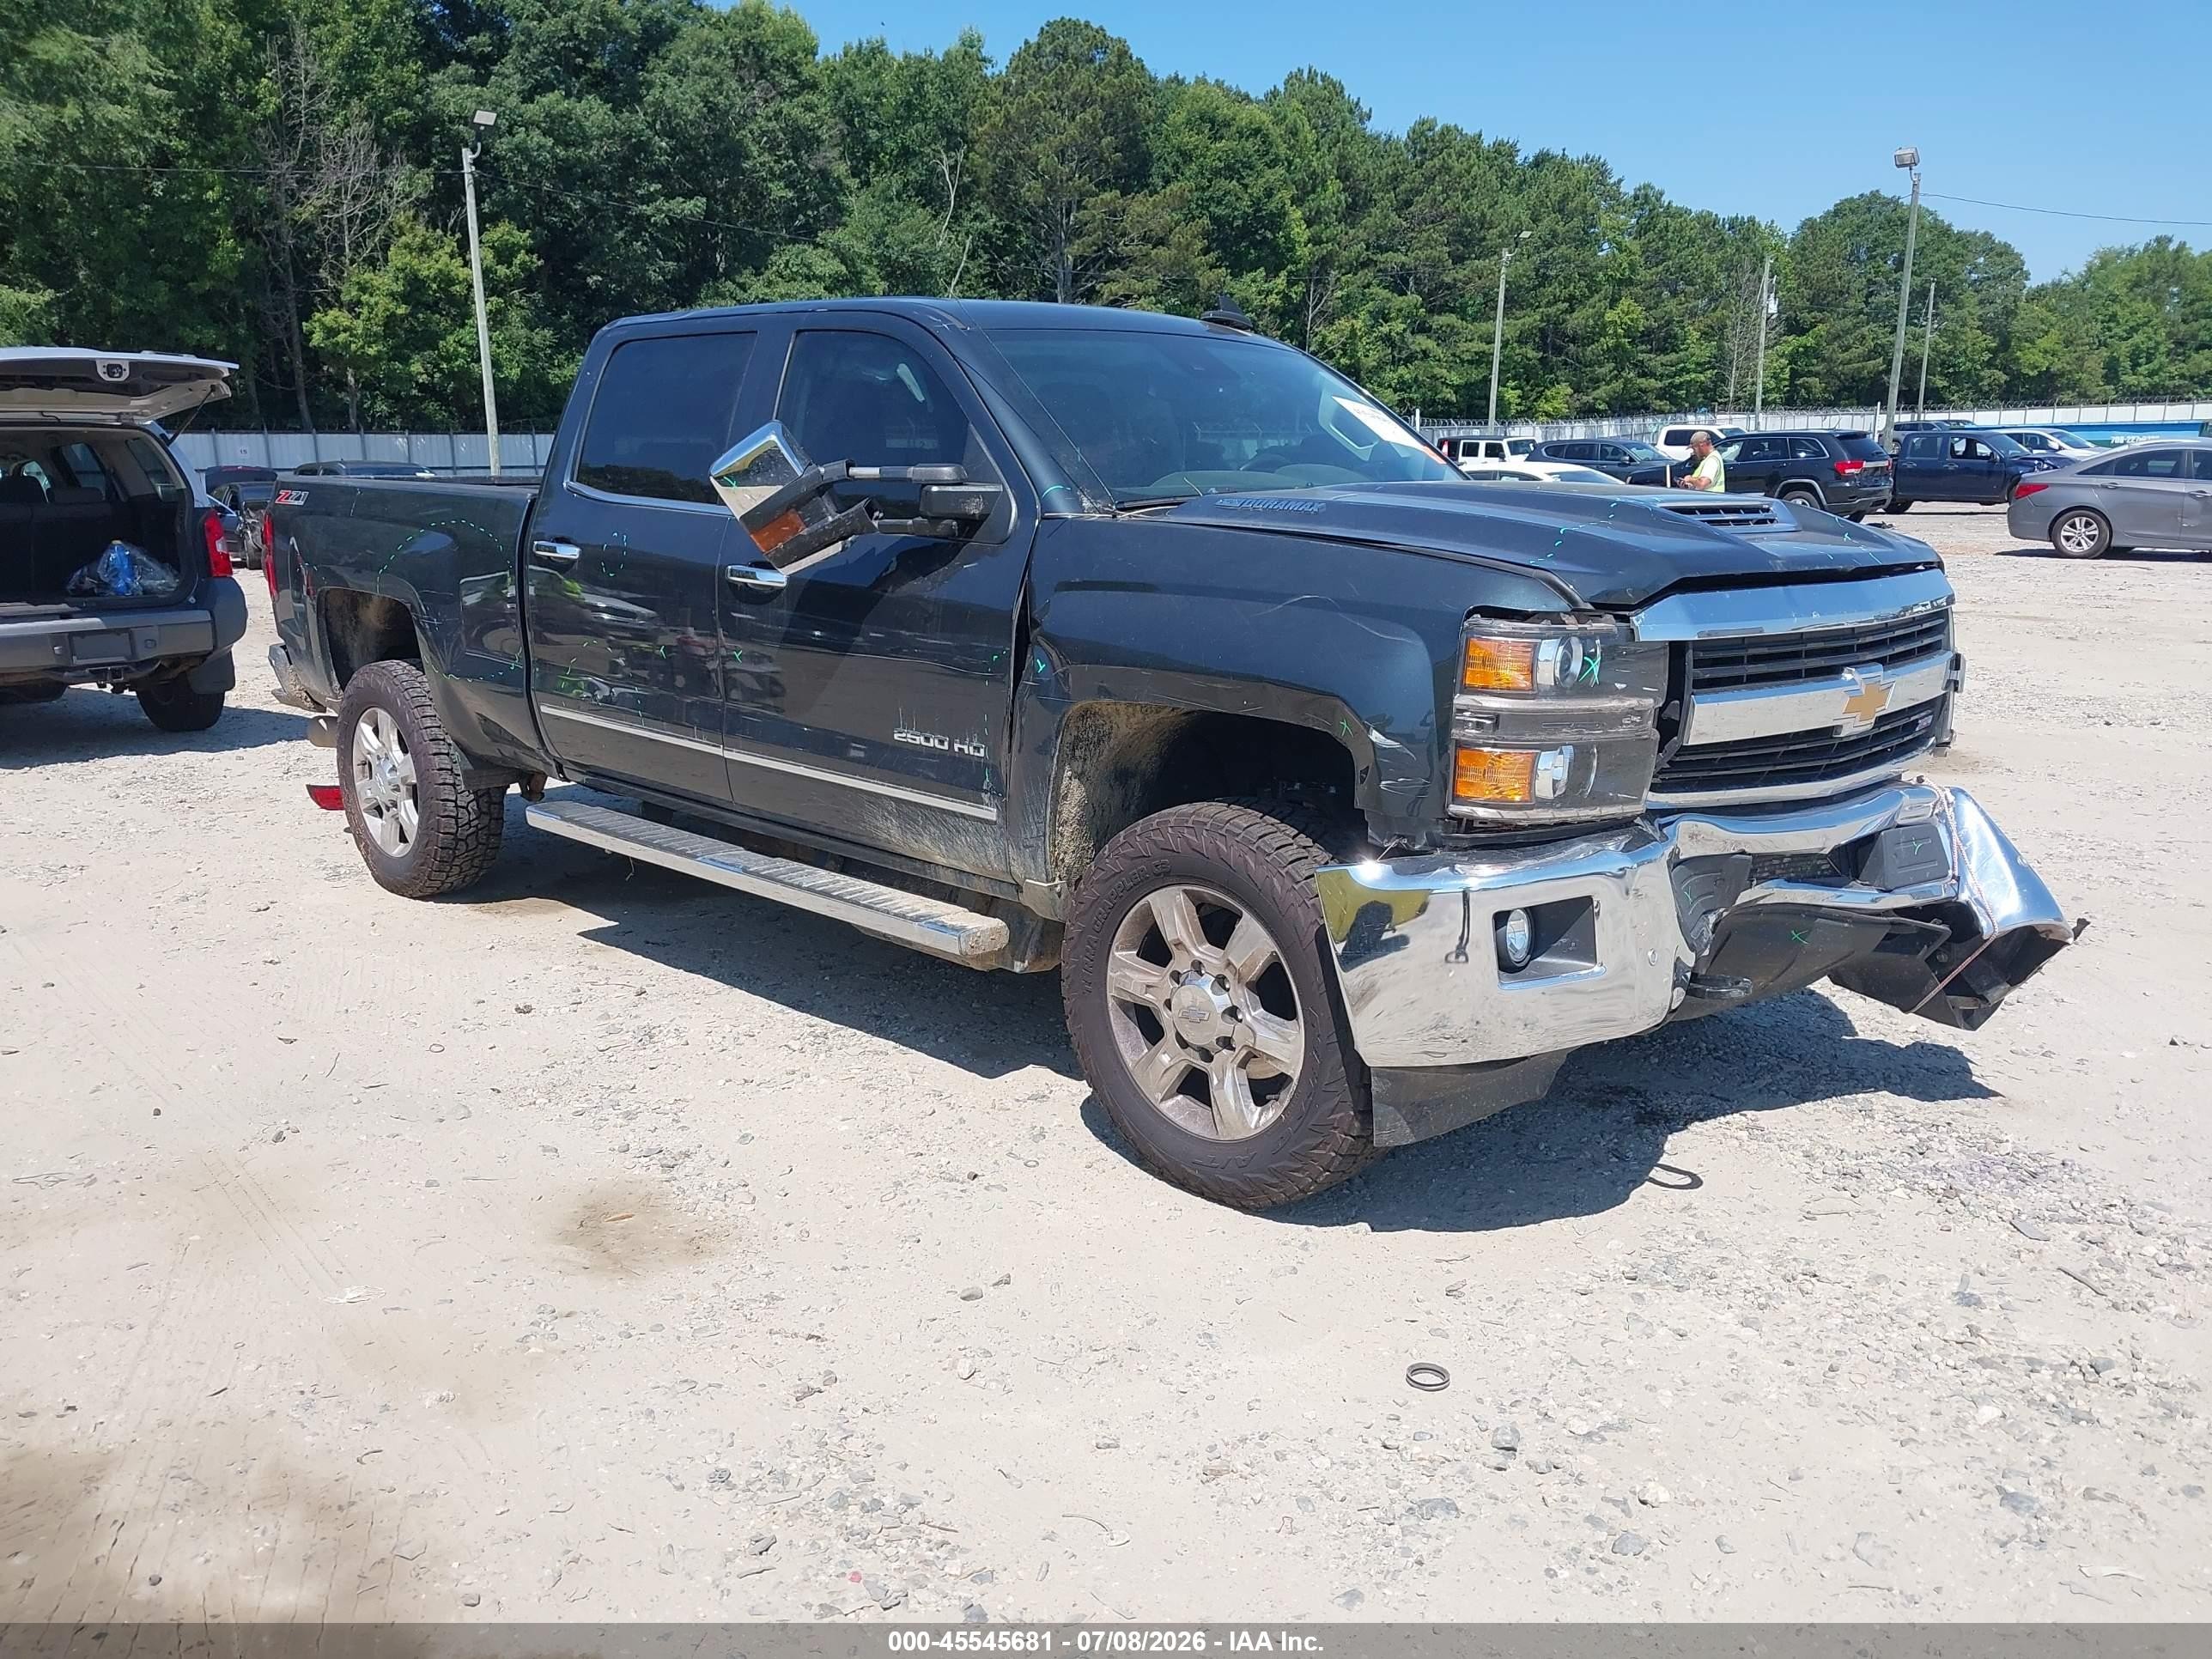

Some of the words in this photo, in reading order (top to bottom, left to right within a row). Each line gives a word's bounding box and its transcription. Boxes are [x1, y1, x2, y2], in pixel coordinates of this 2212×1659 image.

[275, 489, 309, 505] Z71
[1238, 498, 1326, 514] DURAMAX
[894, 727, 949, 750] 2500
[953, 735, 985, 757] HD
[1091, 865, 1151, 933] GRAPPLER
